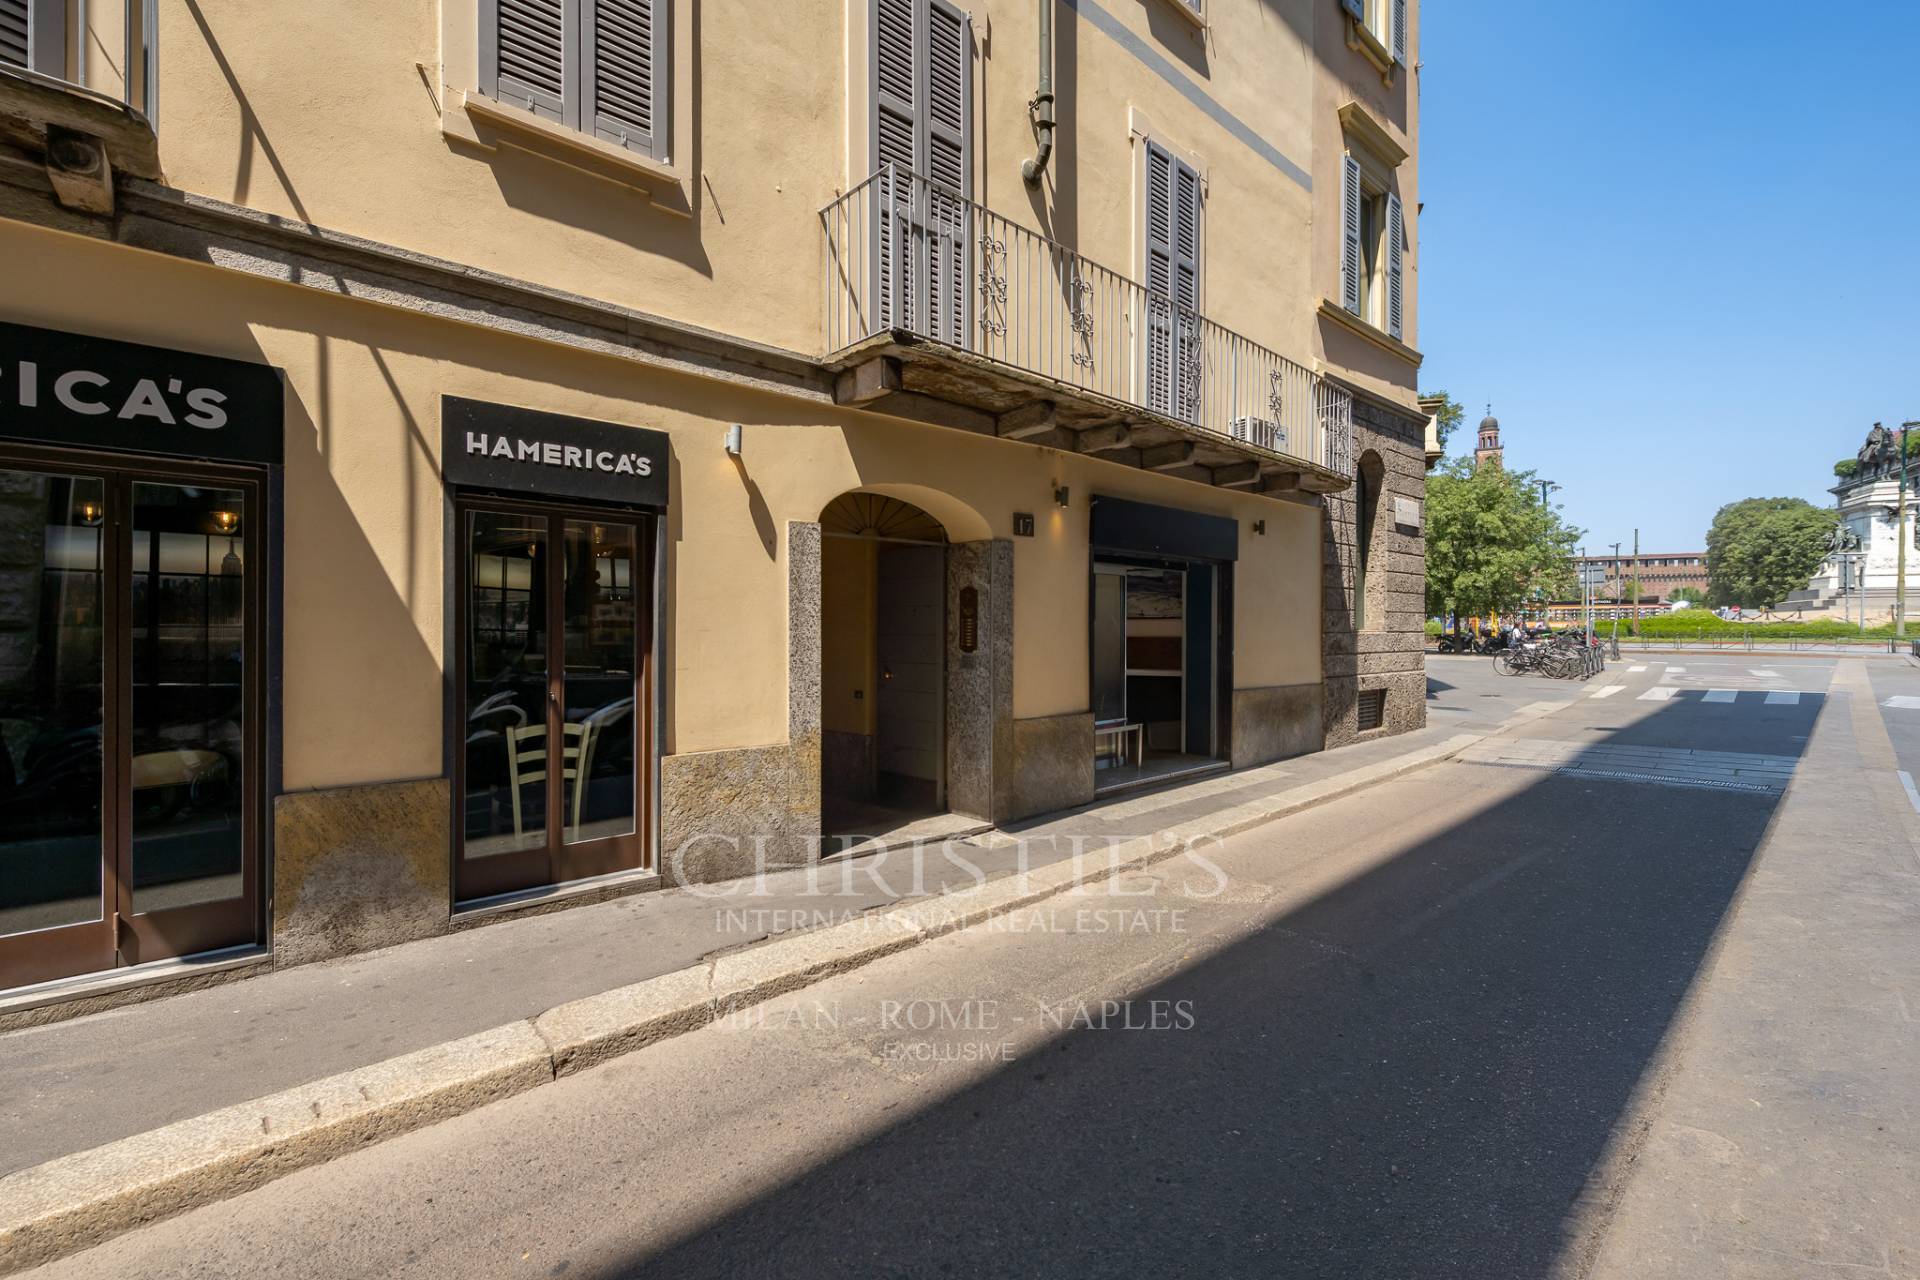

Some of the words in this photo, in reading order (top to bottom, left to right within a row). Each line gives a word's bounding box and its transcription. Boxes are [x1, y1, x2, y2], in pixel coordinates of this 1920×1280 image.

[0, 360, 228, 430] ICA'S
[466, 431, 651, 477] HAMERICA'S
[1018, 518, 1033, 535] 17
